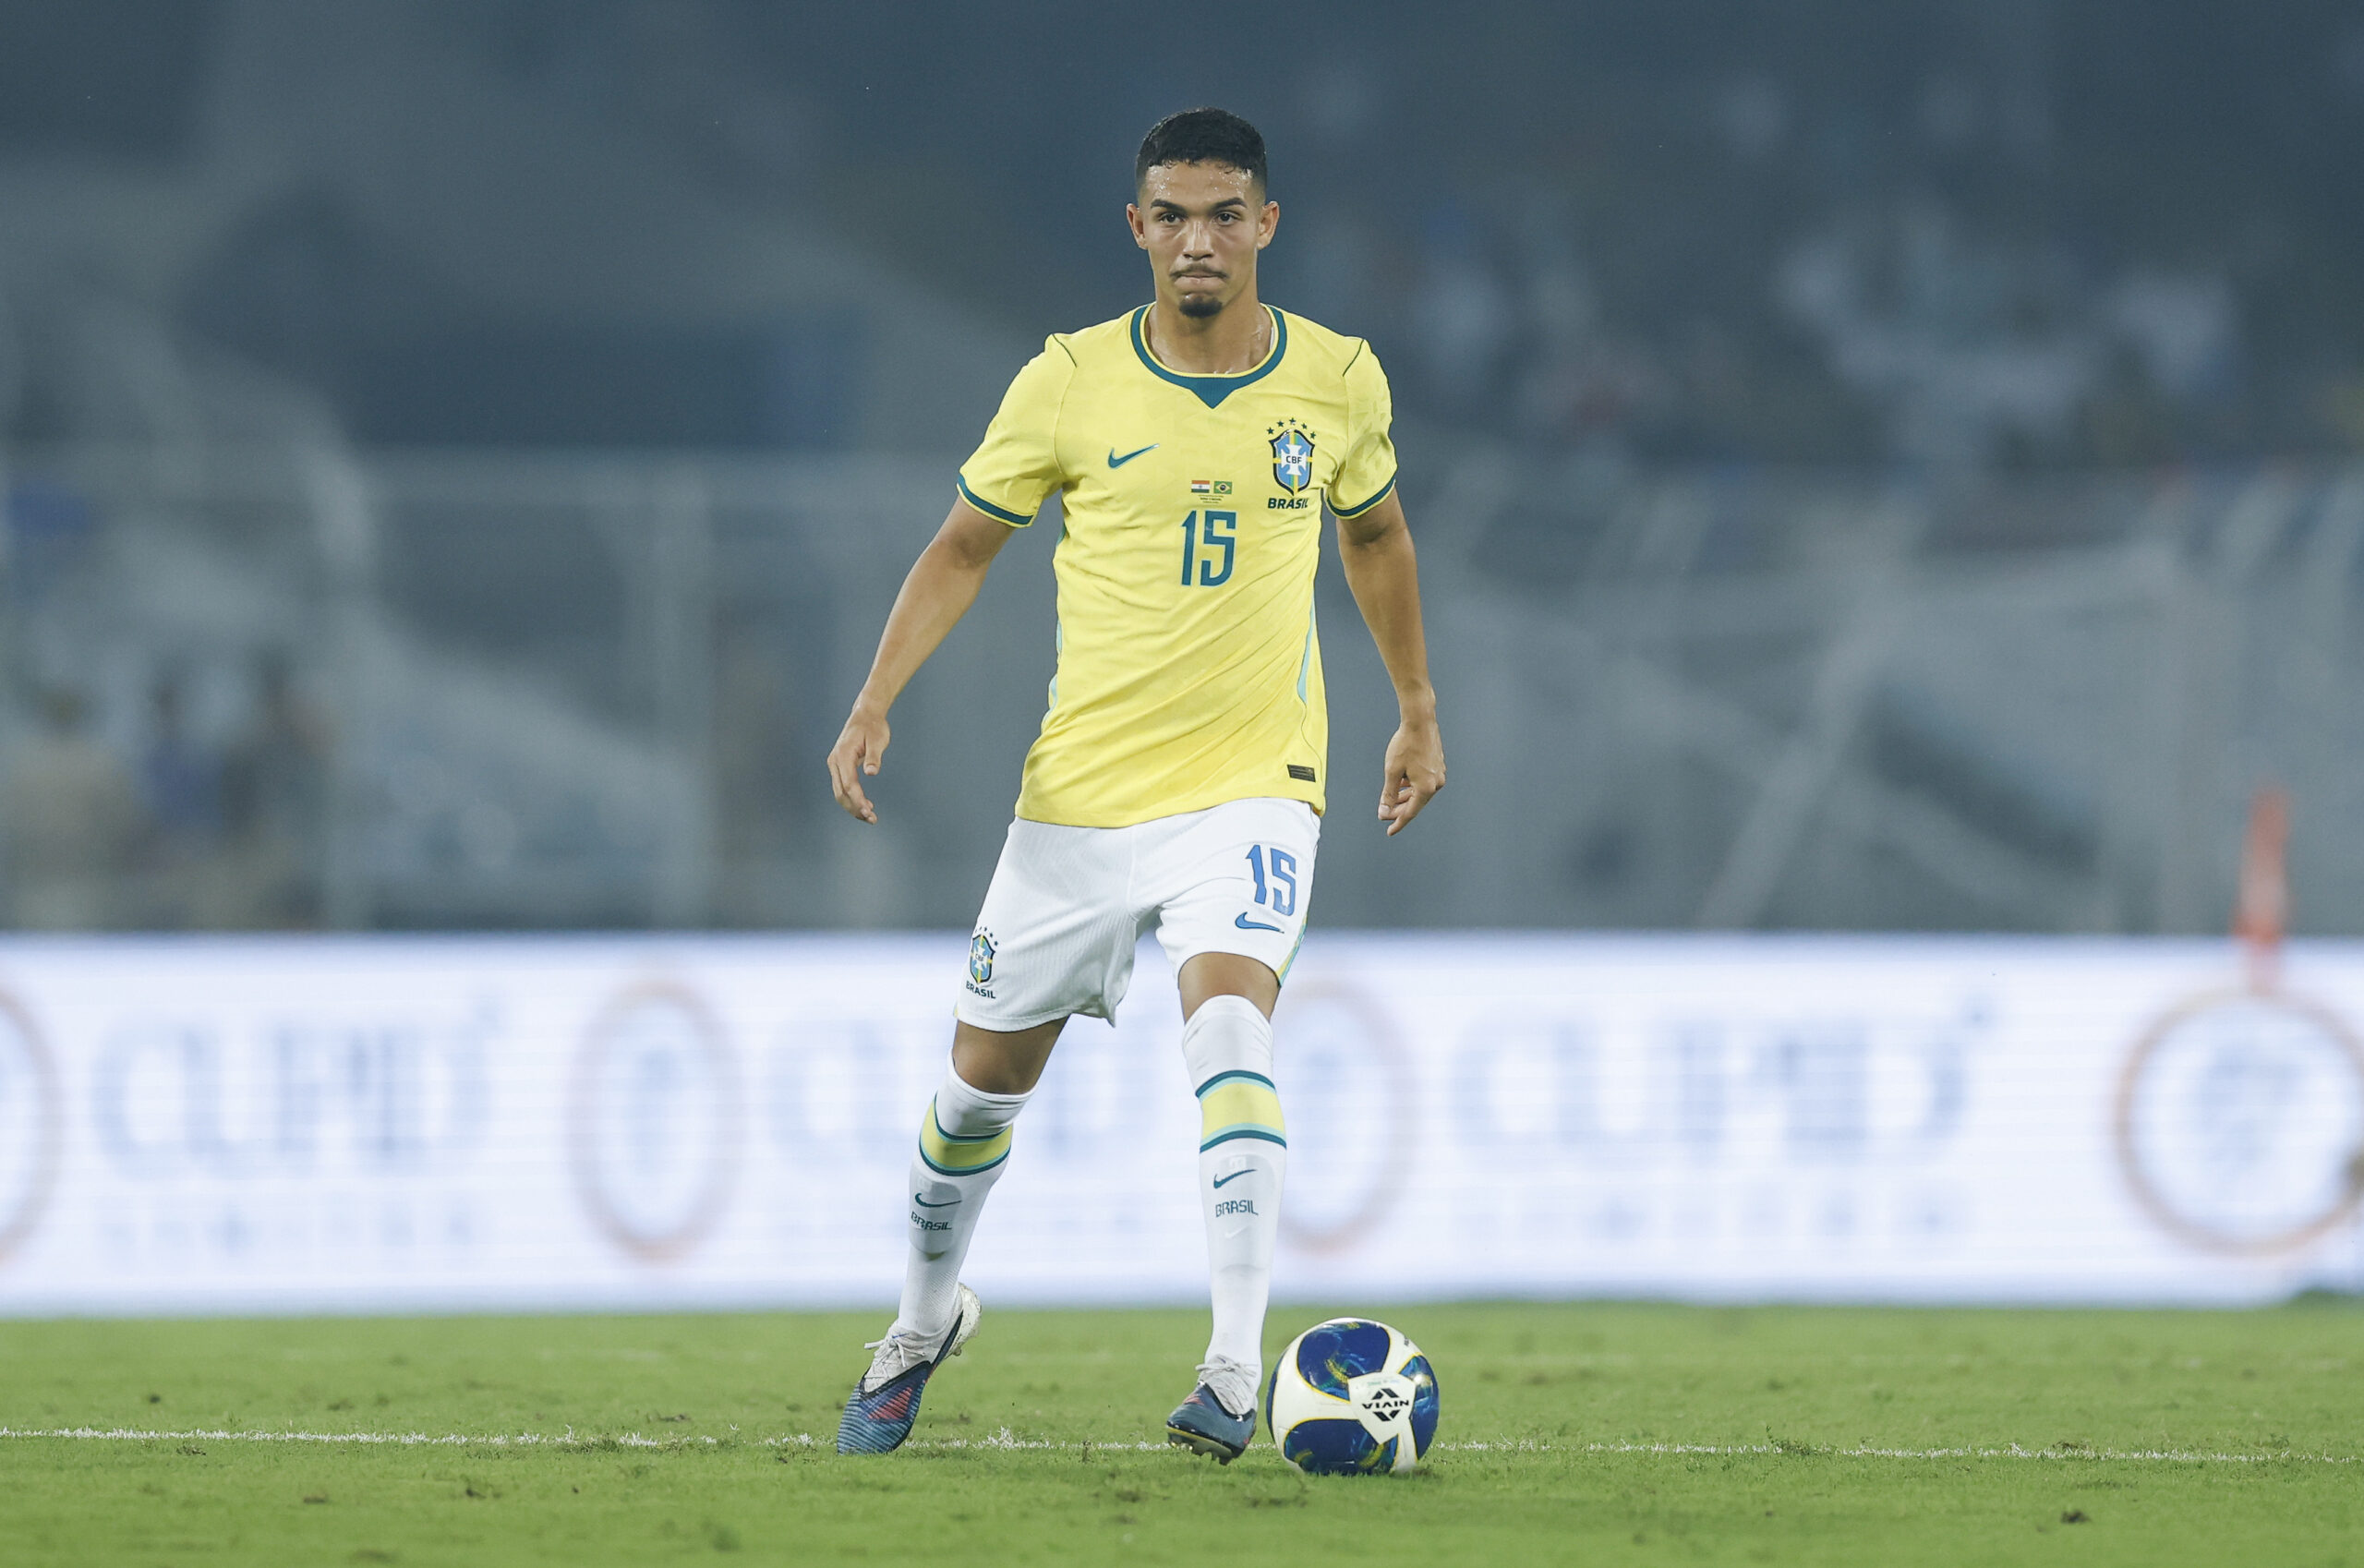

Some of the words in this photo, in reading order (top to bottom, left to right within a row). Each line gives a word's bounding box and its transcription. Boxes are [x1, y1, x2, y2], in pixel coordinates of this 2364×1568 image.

[1285, 455, 1302, 464] CBF
[1267, 498, 1309, 509] BRASIL
[1181, 510, 1237, 585] 15
[1245, 844, 1297, 916] 15
[965, 981, 996, 999] BRASIL
[1214, 1200, 1260, 1218] BRASIL
[911, 1211, 952, 1231] BRASIL
[1362, 1400, 1409, 1409] NIVIA
